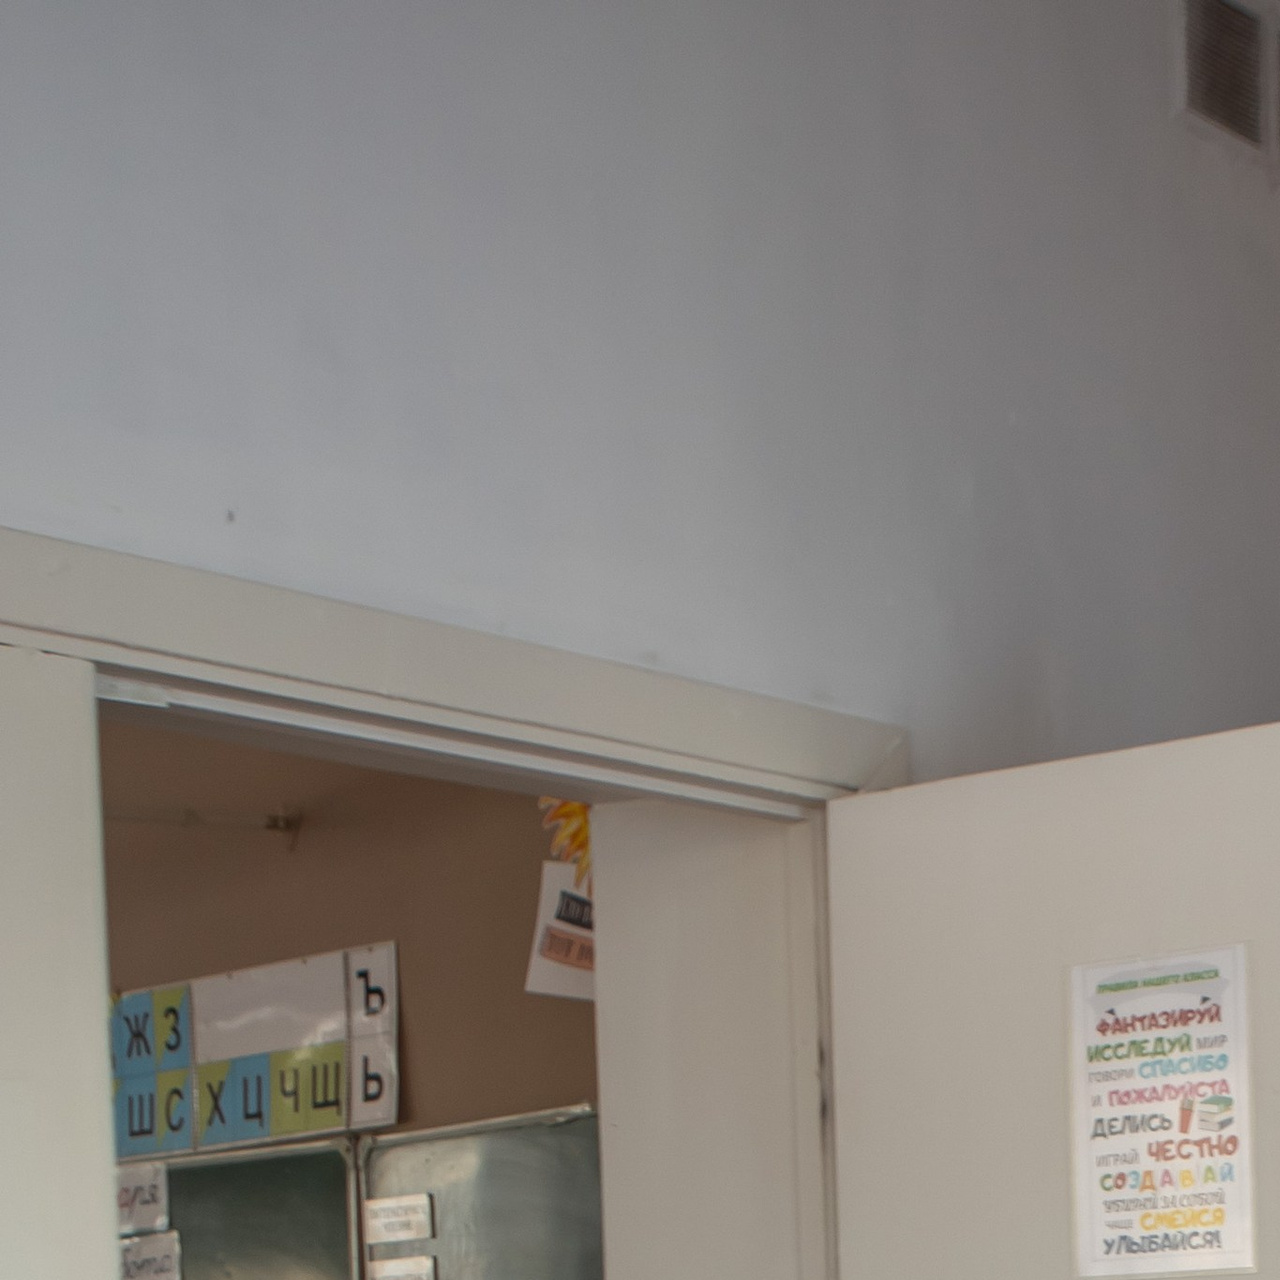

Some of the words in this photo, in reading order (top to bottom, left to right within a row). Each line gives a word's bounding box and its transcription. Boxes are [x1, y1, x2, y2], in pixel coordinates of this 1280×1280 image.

[356, 969, 385, 1016] Ъ
[123, 1012, 152, 1058] Ж
[164, 1007, 180, 1051] З
[1096, 1003, 1222, 1036] ФАНТАЗИРУЙ
[1086, 1034, 1192, 1062] ИССЛЕДУЙ
[1197, 1035, 1227, 1049] МИР
[362, 1056, 382, 1104] Ь
[1088, 1068, 1135, 1083] ГОВОРИ
[1139, 1054, 1228, 1078] СПАСИБО
[128, 1092, 154, 1136] Ш
[166, 1088, 184, 1130] С
[206, 1080, 226, 1126] Х
[243, 1075, 264, 1128] Ц
[280, 1068, 300, 1113] Ч
[312, 1062, 341, 1114] Щ
[1108, 1079, 1230, 1107] ПОЖАЛУЙСТА
[1090, 1114, 1173, 1140] ДЕЛИСЬ
[1096, 1149, 1139, 1167] ИГРАЙ
[1147, 1134, 1239, 1162] ЧЕСТНО
[1100, 1162, 1235, 1192] СОЗДАВАЙ
[1178, 1188, 1225, 1207] СОБОЙ
[1140, 1207, 1225, 1231] СМЕЙСЯ
[1103, 1230, 1222, 1254] УЛЫБАЙСЯ!
